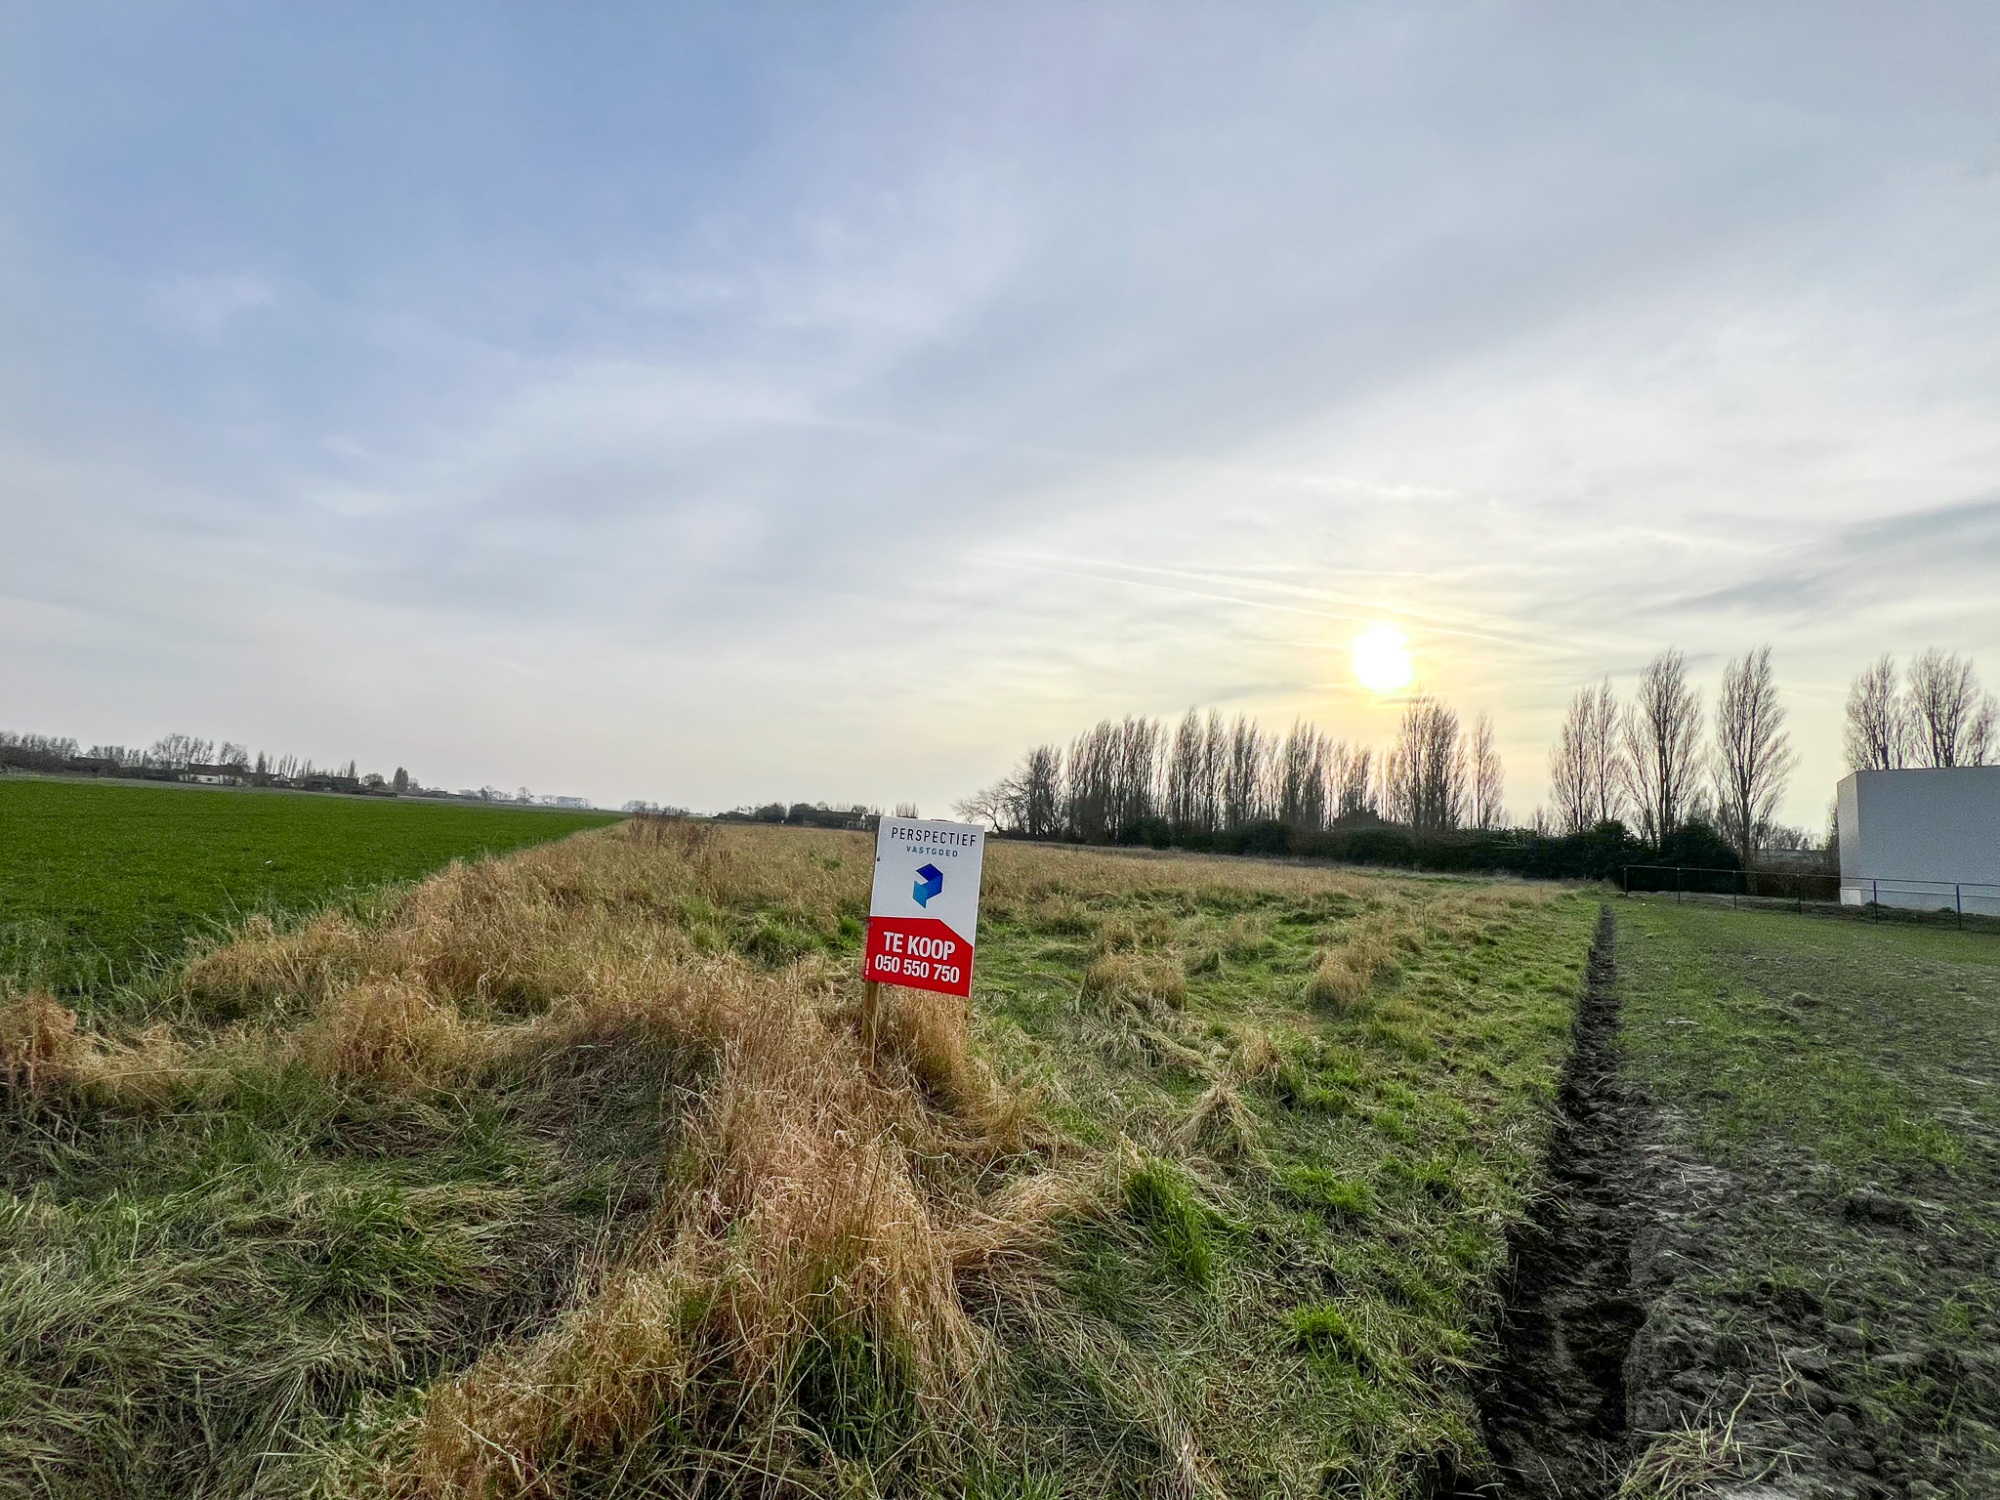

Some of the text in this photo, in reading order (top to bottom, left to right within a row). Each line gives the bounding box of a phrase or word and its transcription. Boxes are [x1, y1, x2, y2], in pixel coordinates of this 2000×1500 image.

[891, 827, 976, 847] PERSPECTIEF
[906, 846, 958, 857] VASTGOED
[883, 931, 956, 961] TE KOOP
[875, 954, 900, 974] 050
[903, 959, 929, 979] 550
[933, 964, 960, 984] 750
